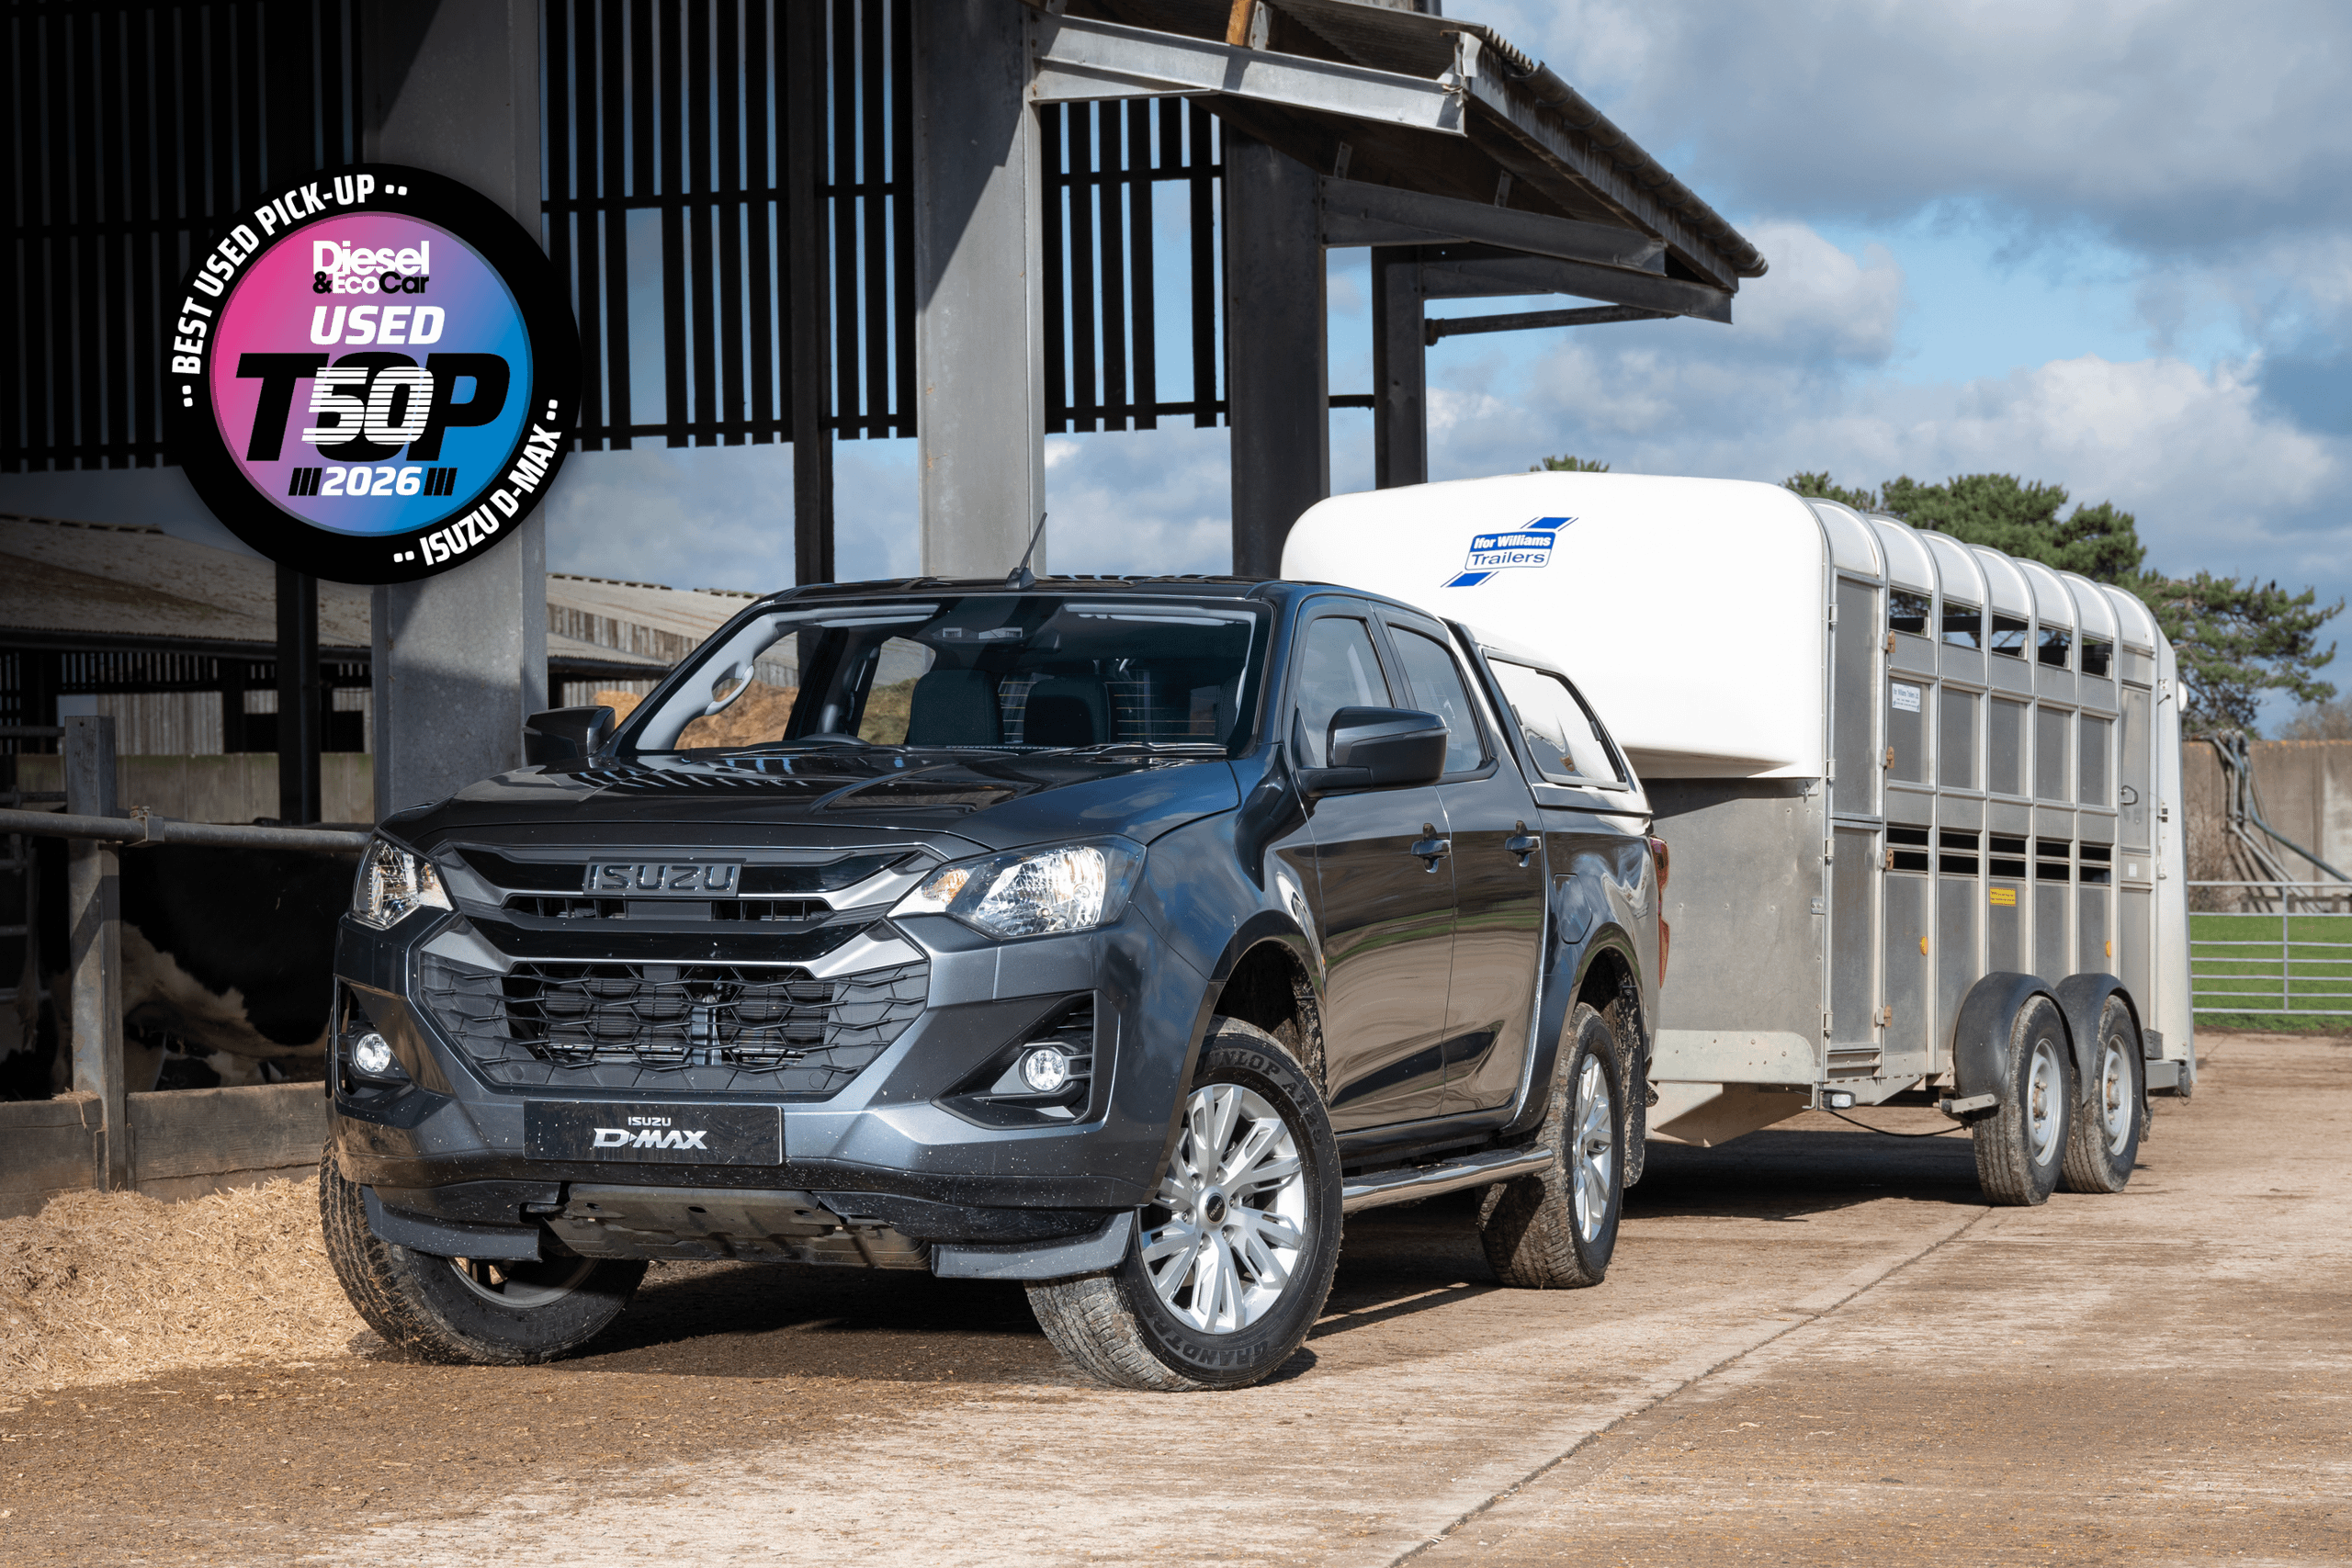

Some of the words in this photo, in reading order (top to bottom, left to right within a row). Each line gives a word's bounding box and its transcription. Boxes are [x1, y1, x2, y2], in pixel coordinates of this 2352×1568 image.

[1474, 537, 1497, 549] Ifor
[1498, 535, 1552, 547] Williams
[1472, 551, 1544, 565] Trailers
[588, 864, 735, 891] ISUZU
[628, 1116, 672, 1127] ISUZU
[594, 1128, 708, 1150] D-MAX
